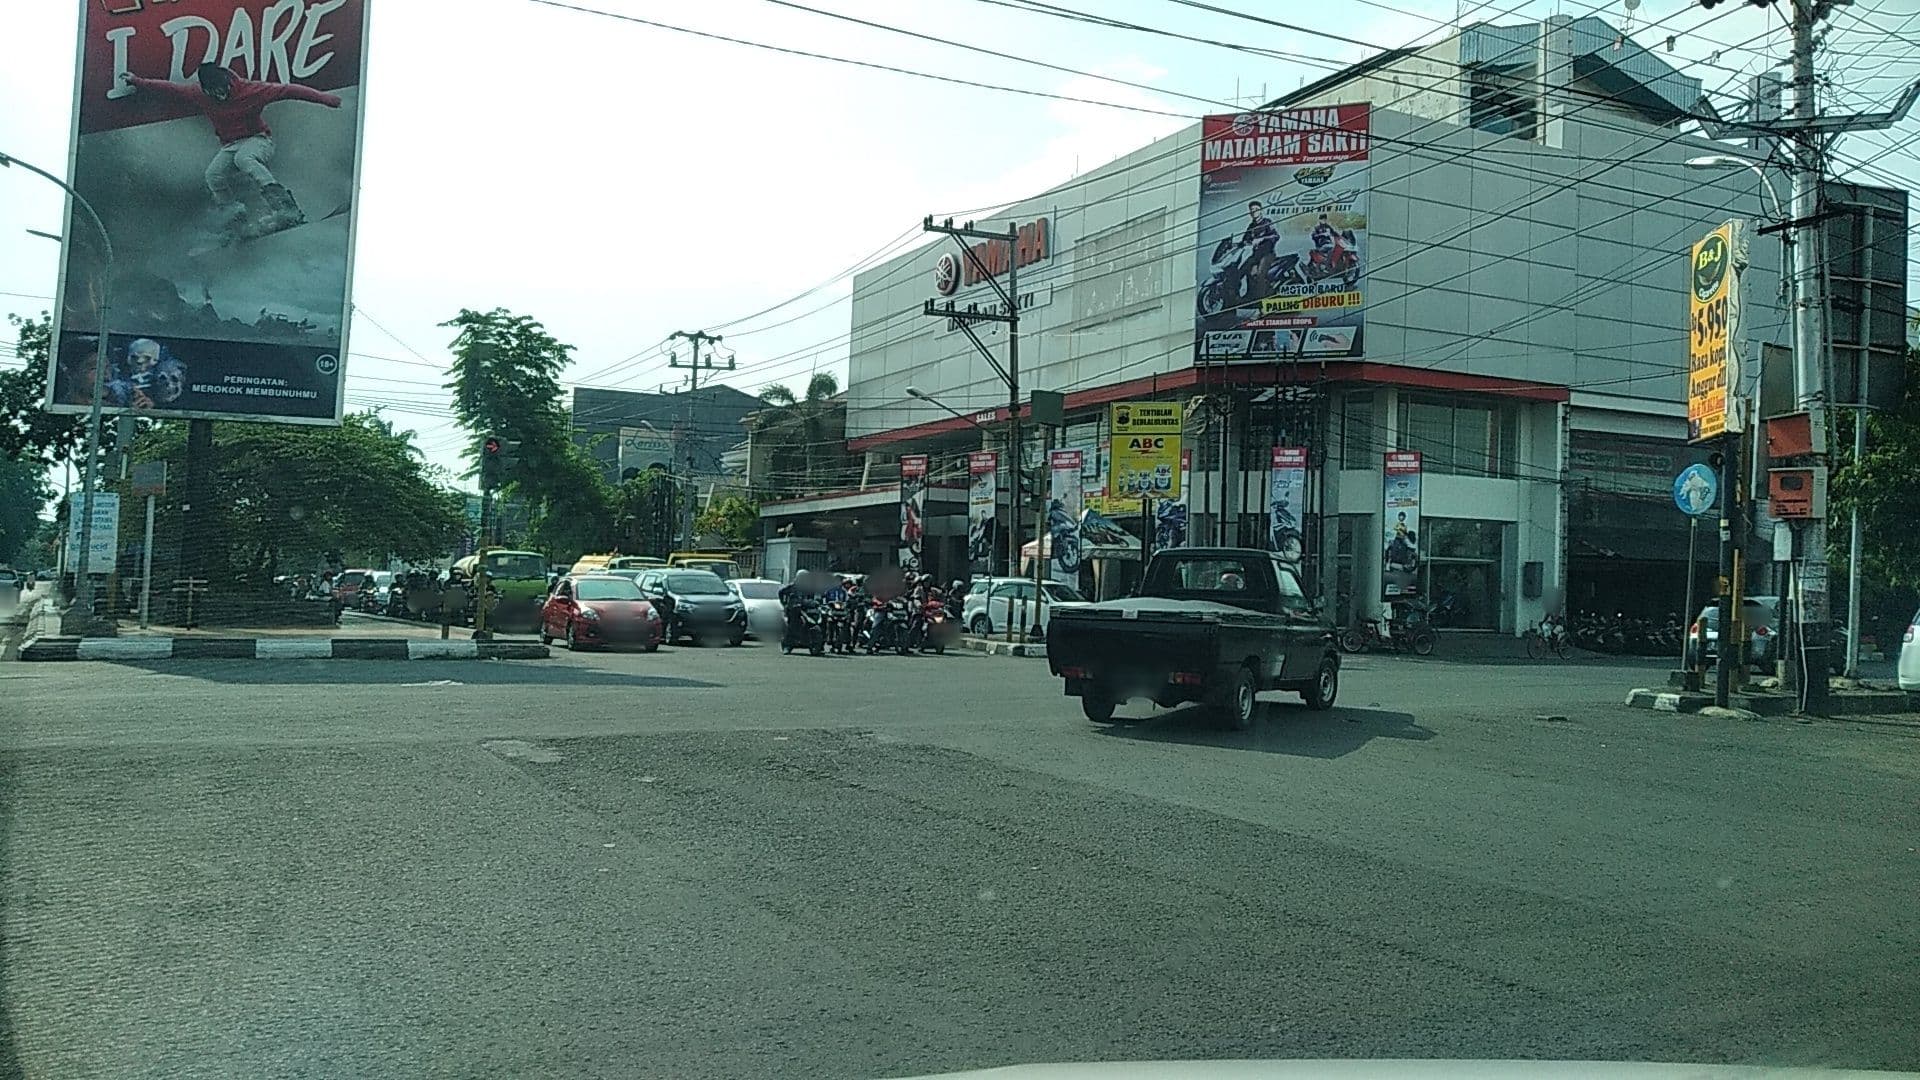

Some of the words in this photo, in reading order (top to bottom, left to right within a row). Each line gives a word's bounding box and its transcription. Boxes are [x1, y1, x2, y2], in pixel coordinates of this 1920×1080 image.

[106, 27, 136, 99] I
[160, 0, 347, 84] DARE
[1257, 108, 1339, 134] YAMAHA
[1205, 134, 1300, 160] MATARAM
[1308, 130, 1367, 153] SAKTI
[1698, 240, 1722, 270] B&J
[1280, 284, 1315, 294] MOTOR
[1317, 284, 1345, 293] BARU
[1266, 302, 1300, 312] PALING
[1302, 295, 1345, 309] DIBURU
[320, 360, 334, 368] 18+
[223, 375, 288, 386] PERINGATAN:
[192, 384, 243, 394] MEROKOK
[245, 387, 317, 398] MEMBUNUHMU
[976, 411, 996, 423] SALES
[1128, 438, 1165, 449] ABC
